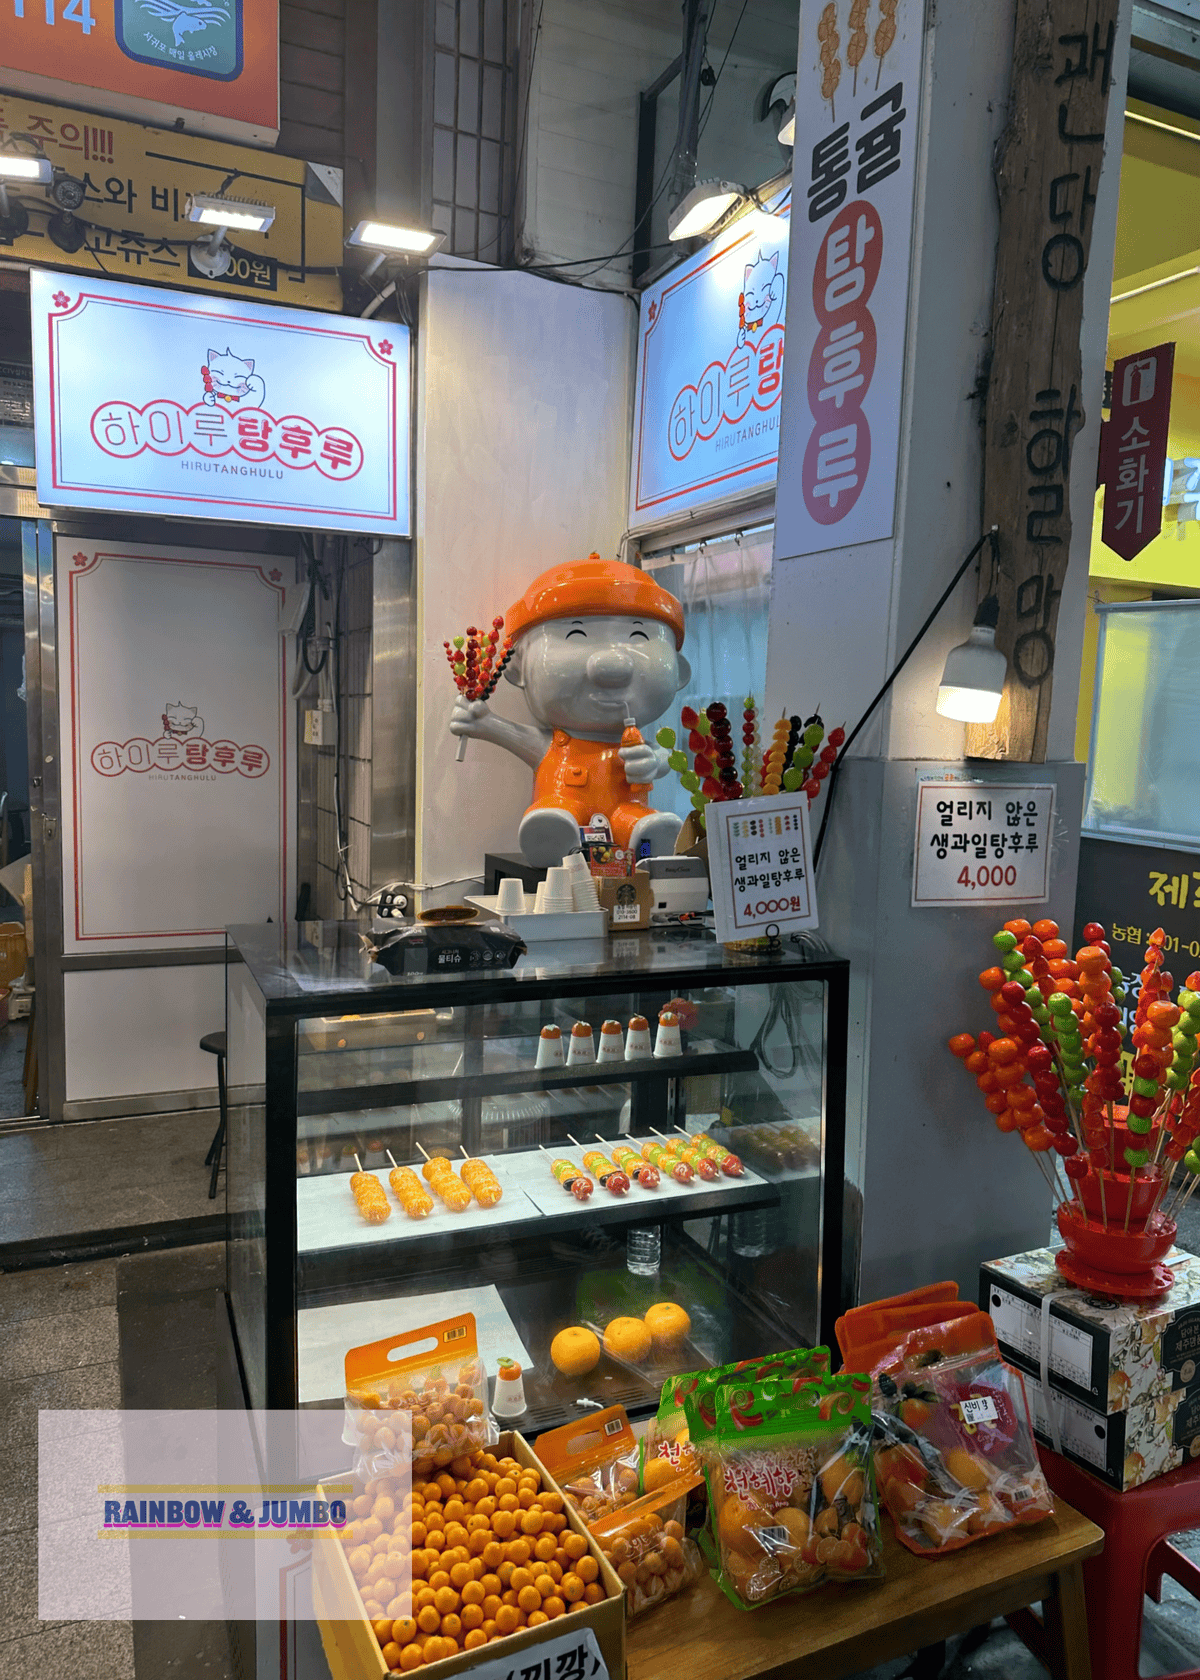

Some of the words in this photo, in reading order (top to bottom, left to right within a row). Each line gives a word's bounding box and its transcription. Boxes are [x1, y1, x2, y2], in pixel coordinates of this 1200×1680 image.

[143, 32, 166, 53] 서귀포
[169, 47, 185, 60] 매일
[27, 114, 114, 164] 주의!!!
[74, 171, 137, 213] 스와
[84, 228, 181, 268] 고쥬스
[225, 256, 272, 287] 00원
[813, 213, 875, 508] 탕후루
[180, 460, 285, 480] HIRUTANGHULU
[1114, 416, 1151, 534] 소화기
[1013, 383, 1083, 689] 할망
[936, 800, 992, 827] 얼리지
[1005, 800, 1039, 827] 않은
[735, 851, 771, 871] 얼리지
[778, 847, 801, 865] 않은
[930, 832, 1039, 859] 생과일탕후루
[734, 867, 805, 892] 생과일탕후루
[957, 865, 1017, 890] 4,000
[743, 895, 801, 919] 4,000원
[1112, 923, 1142, 945] 농협
[438, 953, 462, 964] 물티슈
[724, 1466, 797, 1502] 천혜향
